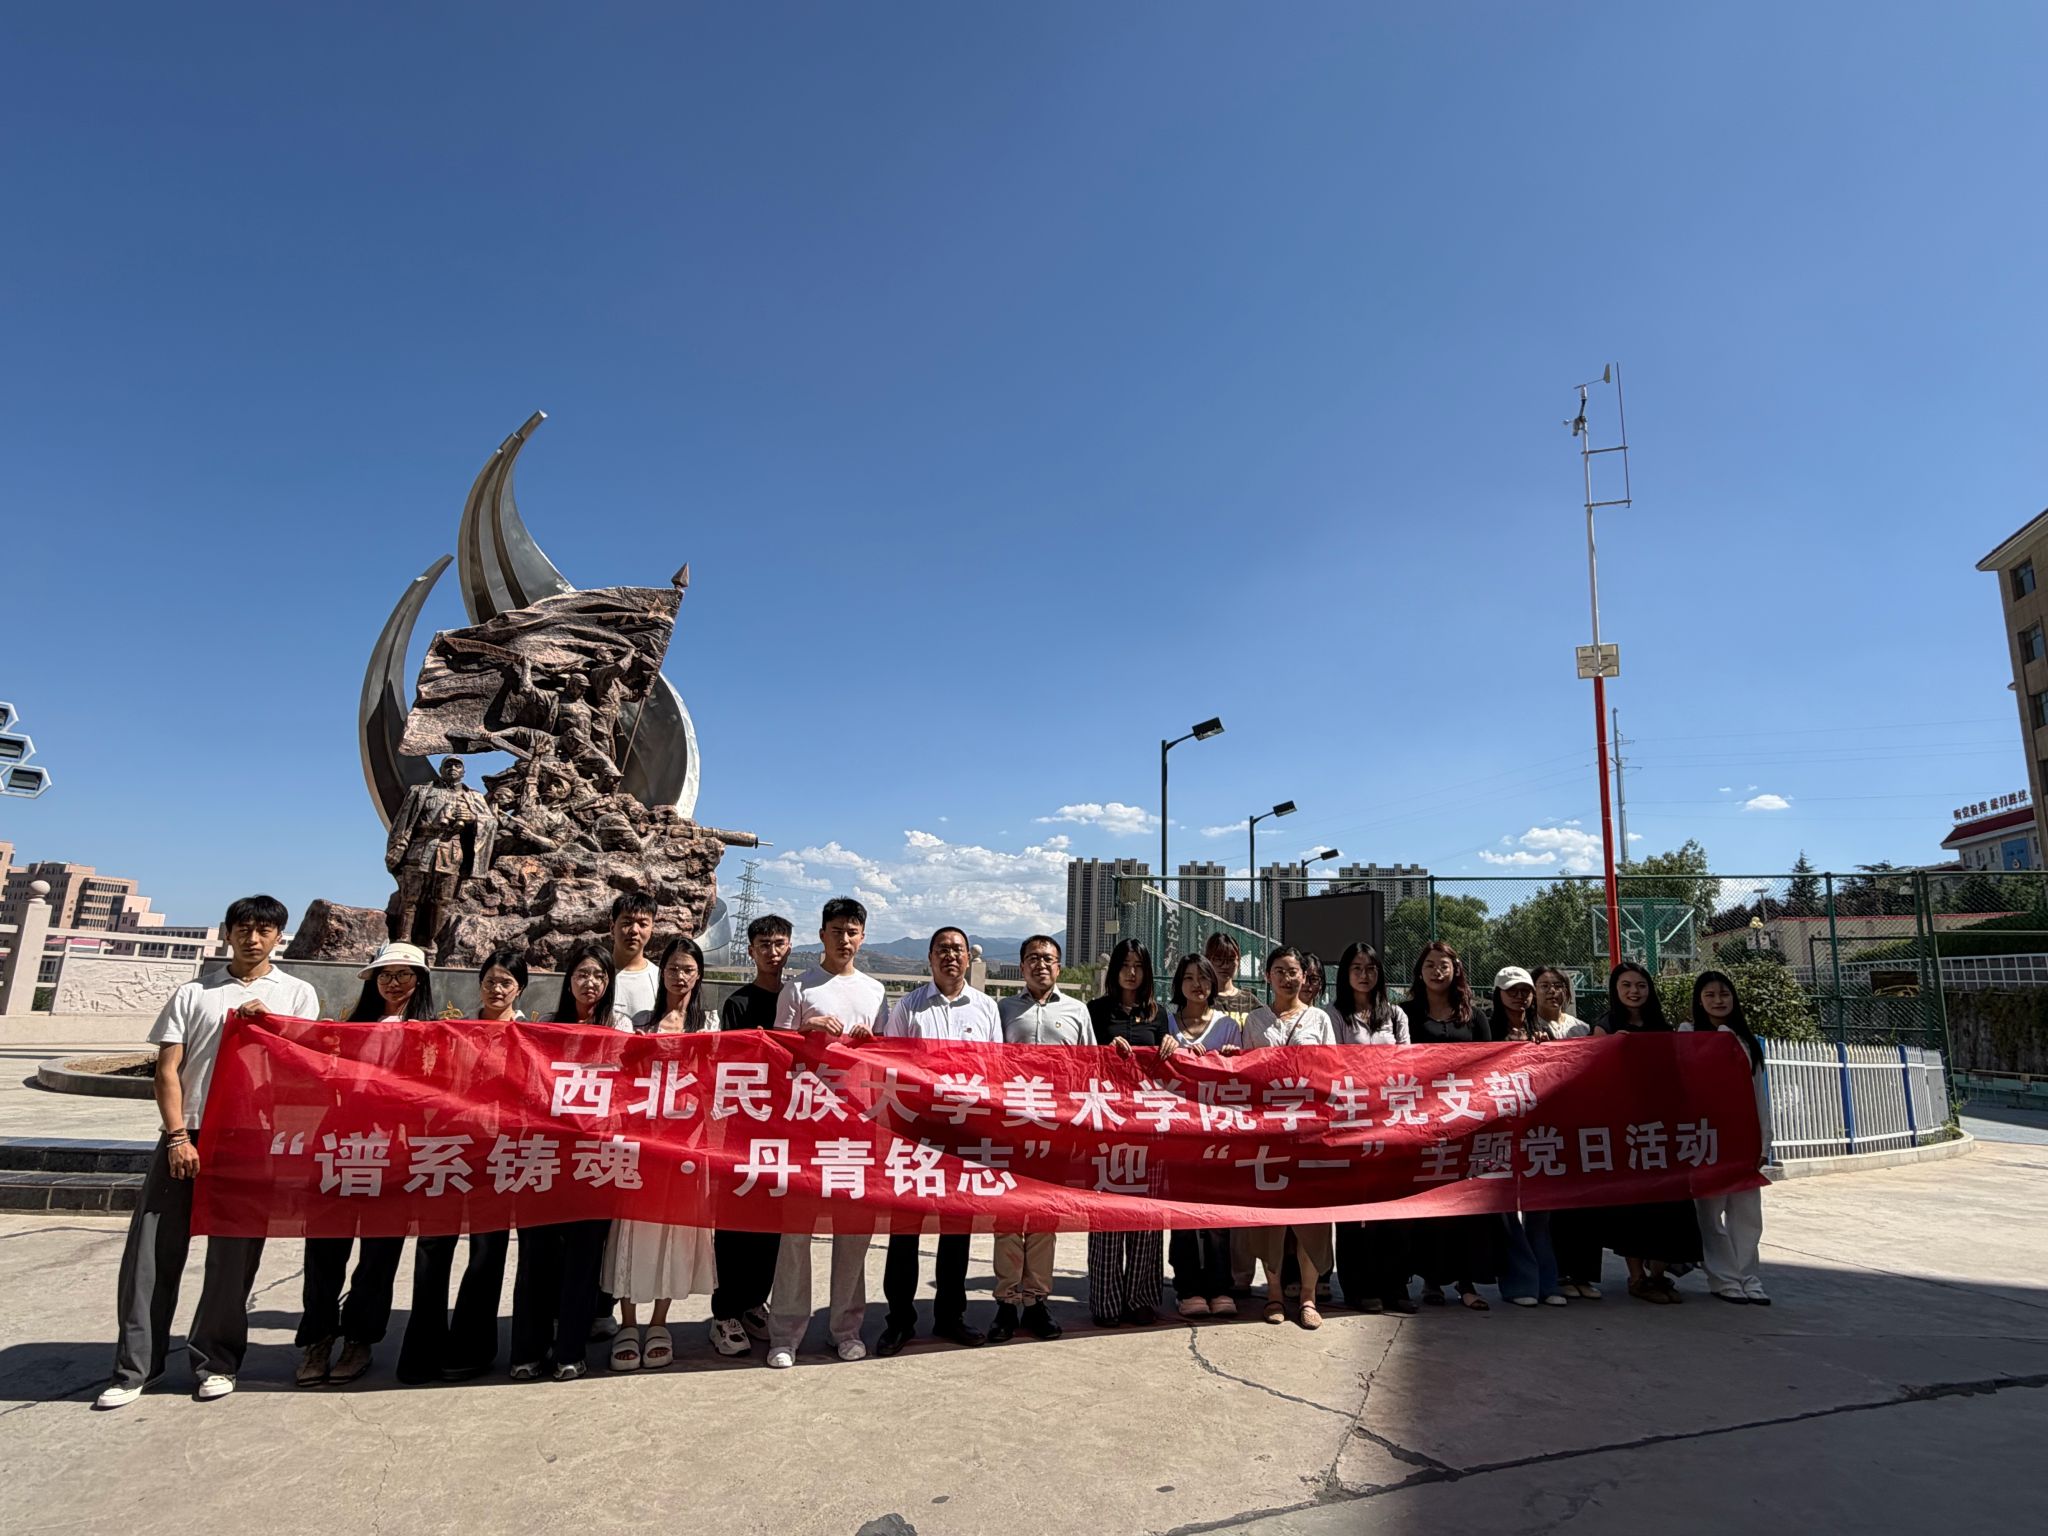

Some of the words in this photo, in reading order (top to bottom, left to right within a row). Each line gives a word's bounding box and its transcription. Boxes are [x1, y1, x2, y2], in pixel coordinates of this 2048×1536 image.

[550, 1060, 1538, 1132] 西北民族大学美术学院学生党支部
